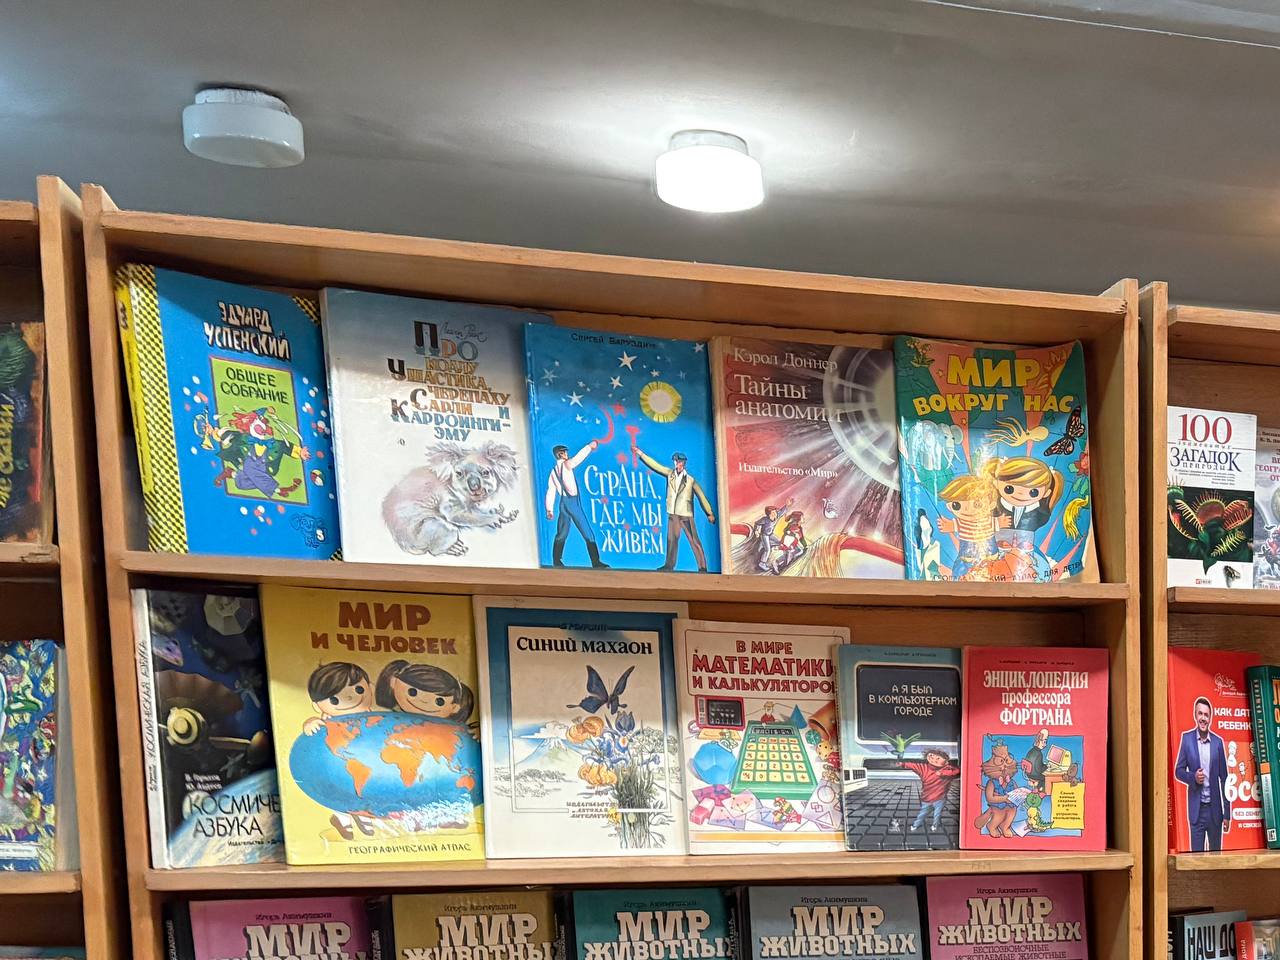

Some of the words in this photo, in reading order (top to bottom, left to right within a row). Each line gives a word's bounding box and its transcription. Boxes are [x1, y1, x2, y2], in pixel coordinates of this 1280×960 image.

[218, 302, 272, 333] ЭДУАРД
[204, 322, 291, 360] УСПЕНСКИЙ
[413, 320, 478, 361] ПРО
[425, 357, 479, 374] КОАЛУ
[734, 347, 779, 366] Кэрол
[782, 352, 838, 370] Доннер
[226, 367, 276, 387] ОБЩЕЕ
[947, 354, 1041, 388] МИР
[220, 382, 289, 405] СОБРАНИЕ
[427, 385, 511, 405] ЧЕРЕПАХУ
[734, 374, 808, 400] Тайны
[410, 388, 473, 415] САРЛИ
[498, 406, 509, 419] И
[735, 400, 842, 422] анатомии
[912, 393, 1009, 417] ВОКРУГ
[1024, 394, 1074, 413] НАС
[434, 427, 470, 441] ЭМУ
[1178, 413, 1232, 445] 100
[738, 462, 804, 476] Издательство
[805, 466, 838, 478] «Мир»
[1170, 446, 1241, 473] ЗАГАДОК
[583, 463, 661, 502] СТРАНА,
[591, 497, 625, 527] ГДЕ
[631, 504, 663, 528] МЫ
[338, 601, 431, 631] МИР
[311, 632, 329, 649] И
[337, 633, 458, 655] ЧЕЛОВЕК
[581, 640, 652, 656] махаон
[735, 640, 746, 654] В
[750, 641, 793, 655] МИРЕ
[692, 675, 702, 689] И
[892, 684, 899, 693] А
[902, 684, 909, 694] Я
[911, 684, 933, 694] БЫЛ
[983, 670, 1089, 690] ЭНЦИКЛОПЕДИЯ
[869, 694, 876, 703] В
[878, 695, 957, 706] КОМПЬЮТЕРНОМ
[1001, 689, 1071, 706] профессора
[894, 706, 933, 717] ГОРОДЕ
[999, 707, 1073, 726] ФОРТРАНА
[1214, 707, 1232, 716] КАК
[193, 816, 262, 838] АЗБУКА
[349, 841, 438, 856] ГЕОГРАФИЧЕСКИЙ
[440, 842, 471, 853] АТЛАС
[792, 904, 886, 937] МИР
[968, 896, 1054, 925] МИР
[436, 912, 538, 948] МИР
[614, 908, 711, 942] МИР
[938, 922, 1082, 945] ЖИВОТНЫХ
[245, 921, 352, 958] МИР
[760, 933, 917, 959] ЖИВОТНЫХ
[1017, 951, 1067, 960] ЖИВОТНЫЕ
